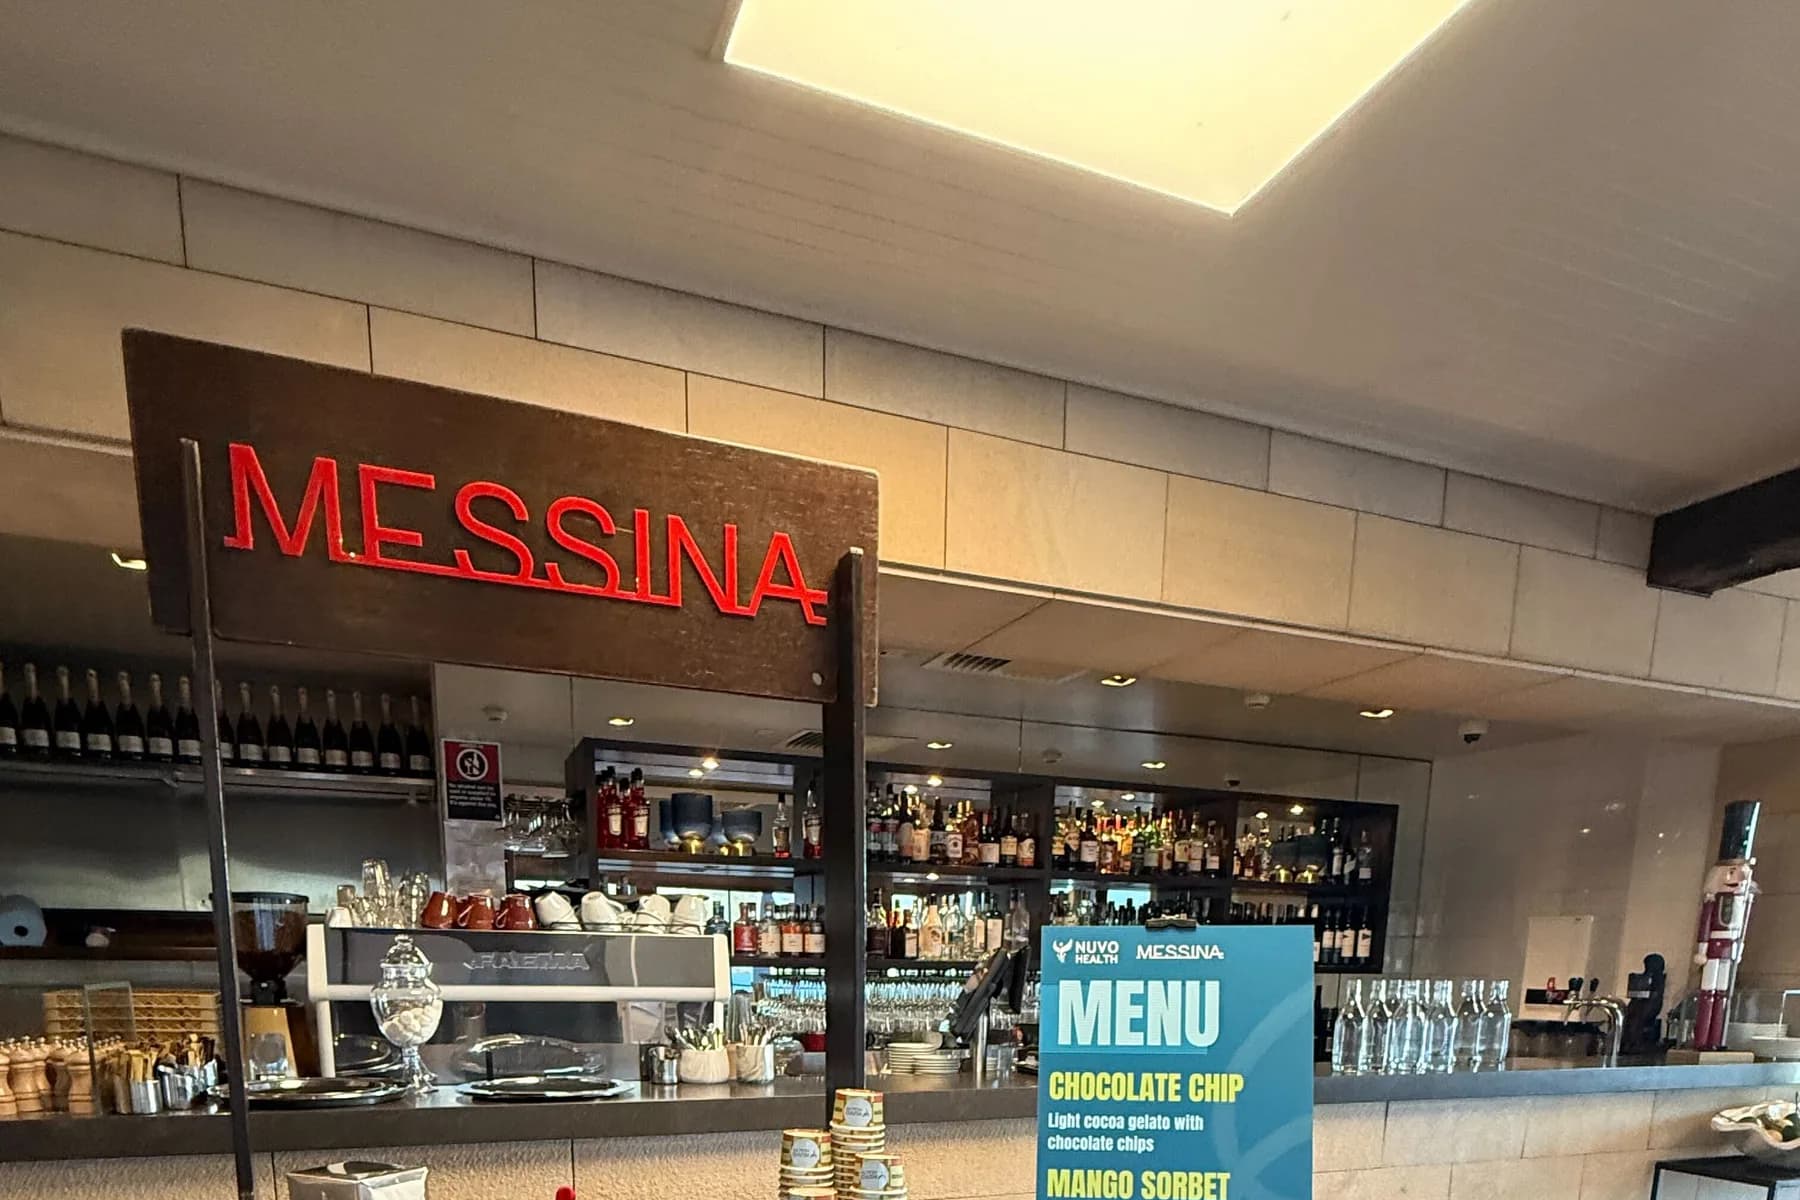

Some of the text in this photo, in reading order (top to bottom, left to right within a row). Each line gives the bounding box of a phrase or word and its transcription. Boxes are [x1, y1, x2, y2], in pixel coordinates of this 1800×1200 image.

[224, 443, 828, 626] MESSINA
[1075, 940, 1120, 954] NUVO
[1135, 944, 1225, 960] MESSINA
[1075, 954, 1119, 964] HEALTH
[1057, 979, 1220, 1047] MENU
[1049, 1071, 1244, 1103] CHOCOLATE CHIP
[1047, 1112, 1204, 1131] Light cocoa gelato with
[1047, 1134, 1155, 1154] chocolate chips
[1047, 1168, 1134, 1200] MANGO
